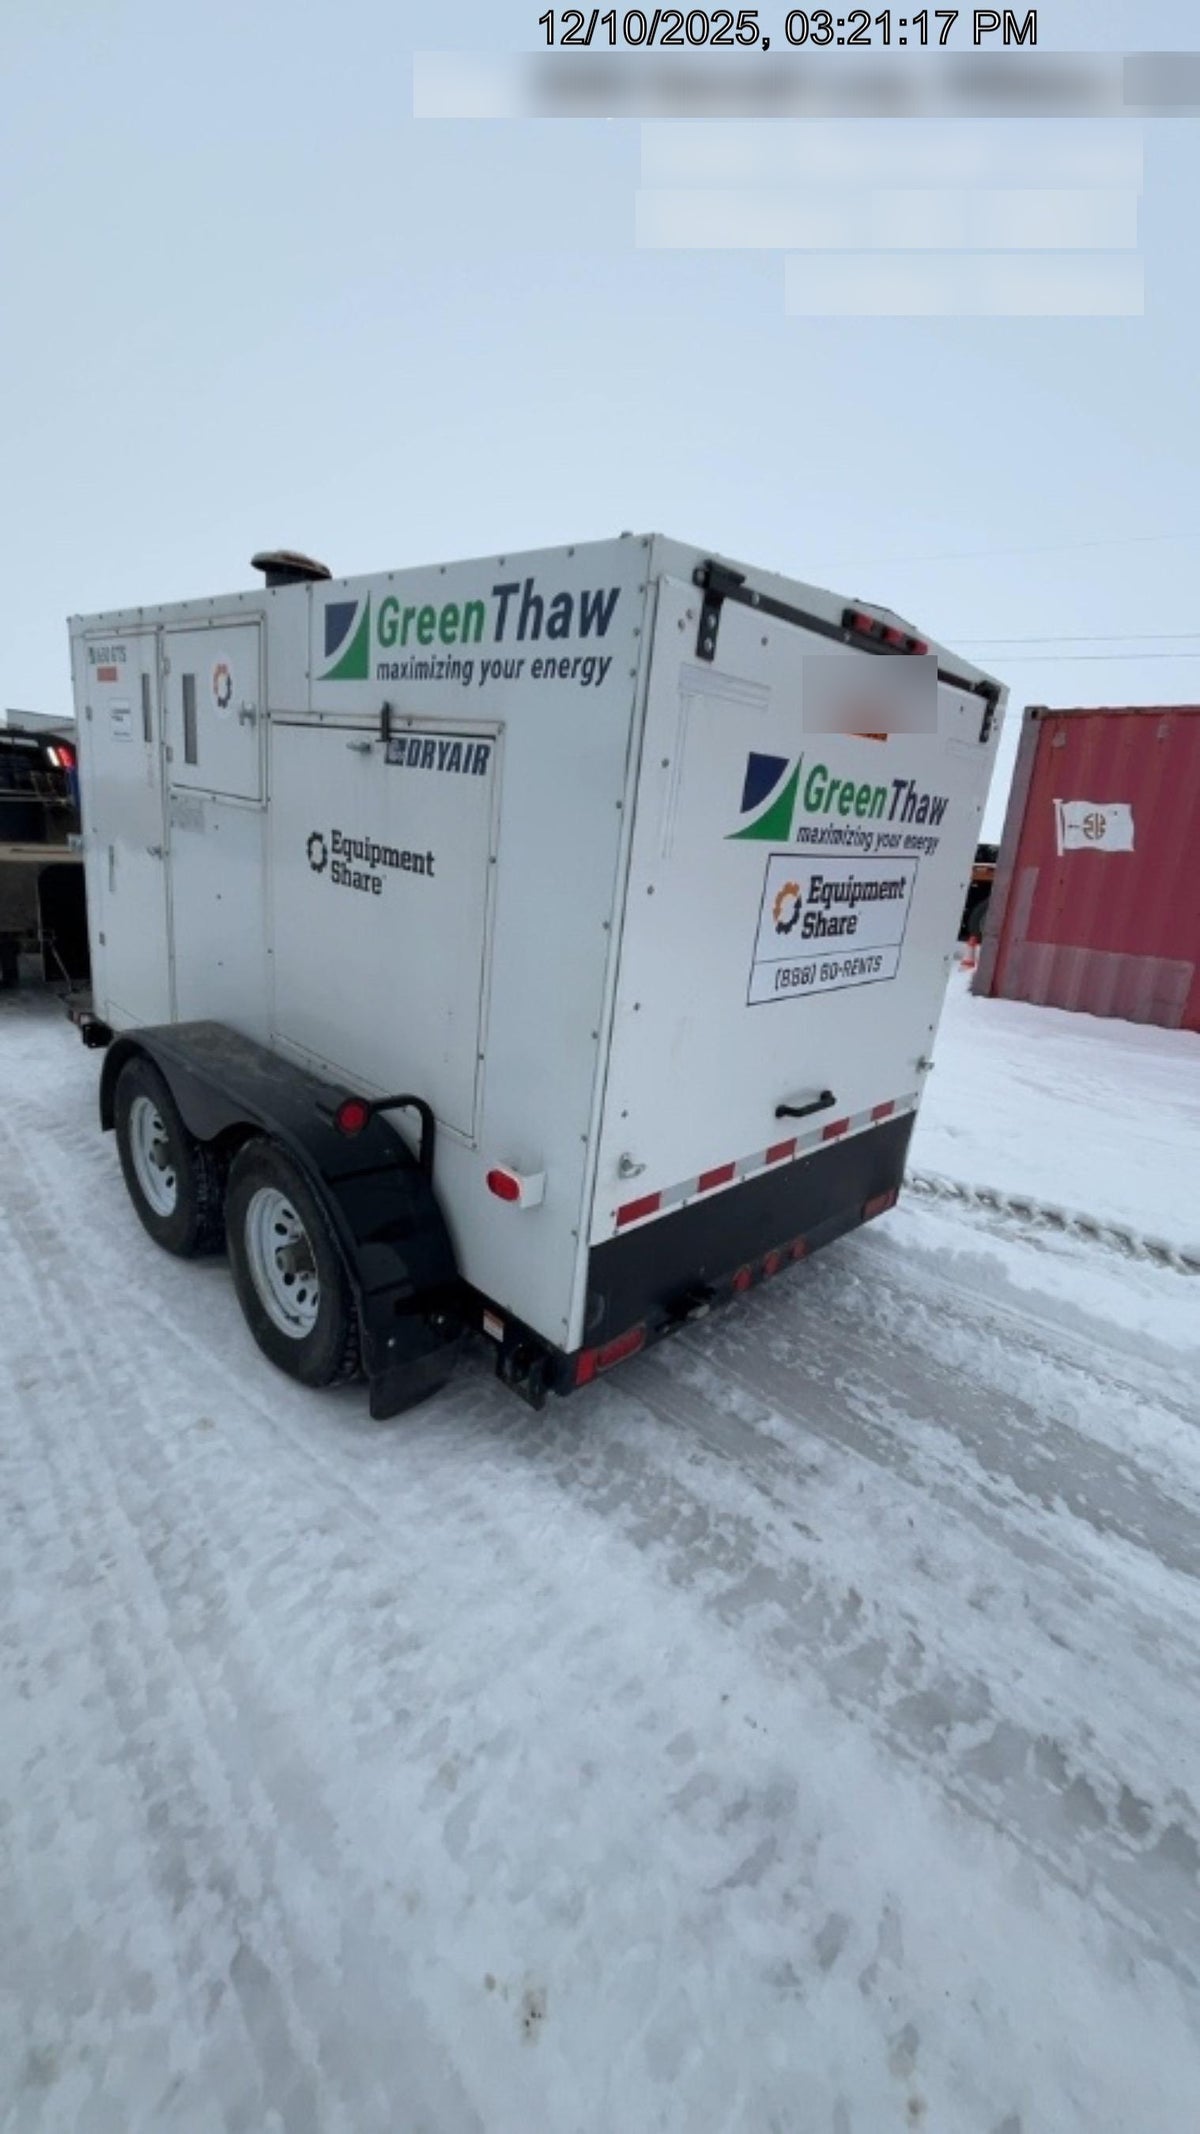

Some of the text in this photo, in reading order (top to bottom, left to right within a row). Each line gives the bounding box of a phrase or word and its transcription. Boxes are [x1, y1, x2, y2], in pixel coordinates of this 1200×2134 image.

[376, 654, 612, 687] maximizing your energy
[406, 738, 492, 776] DRYAIR
[331, 829, 436, 878] Equipment
[797, 824, 940, 855] maximizing your energy
[331, 860, 383, 896] Share
[806, 875, 906, 909] Equipment
[801, 911, 858, 940] Share
